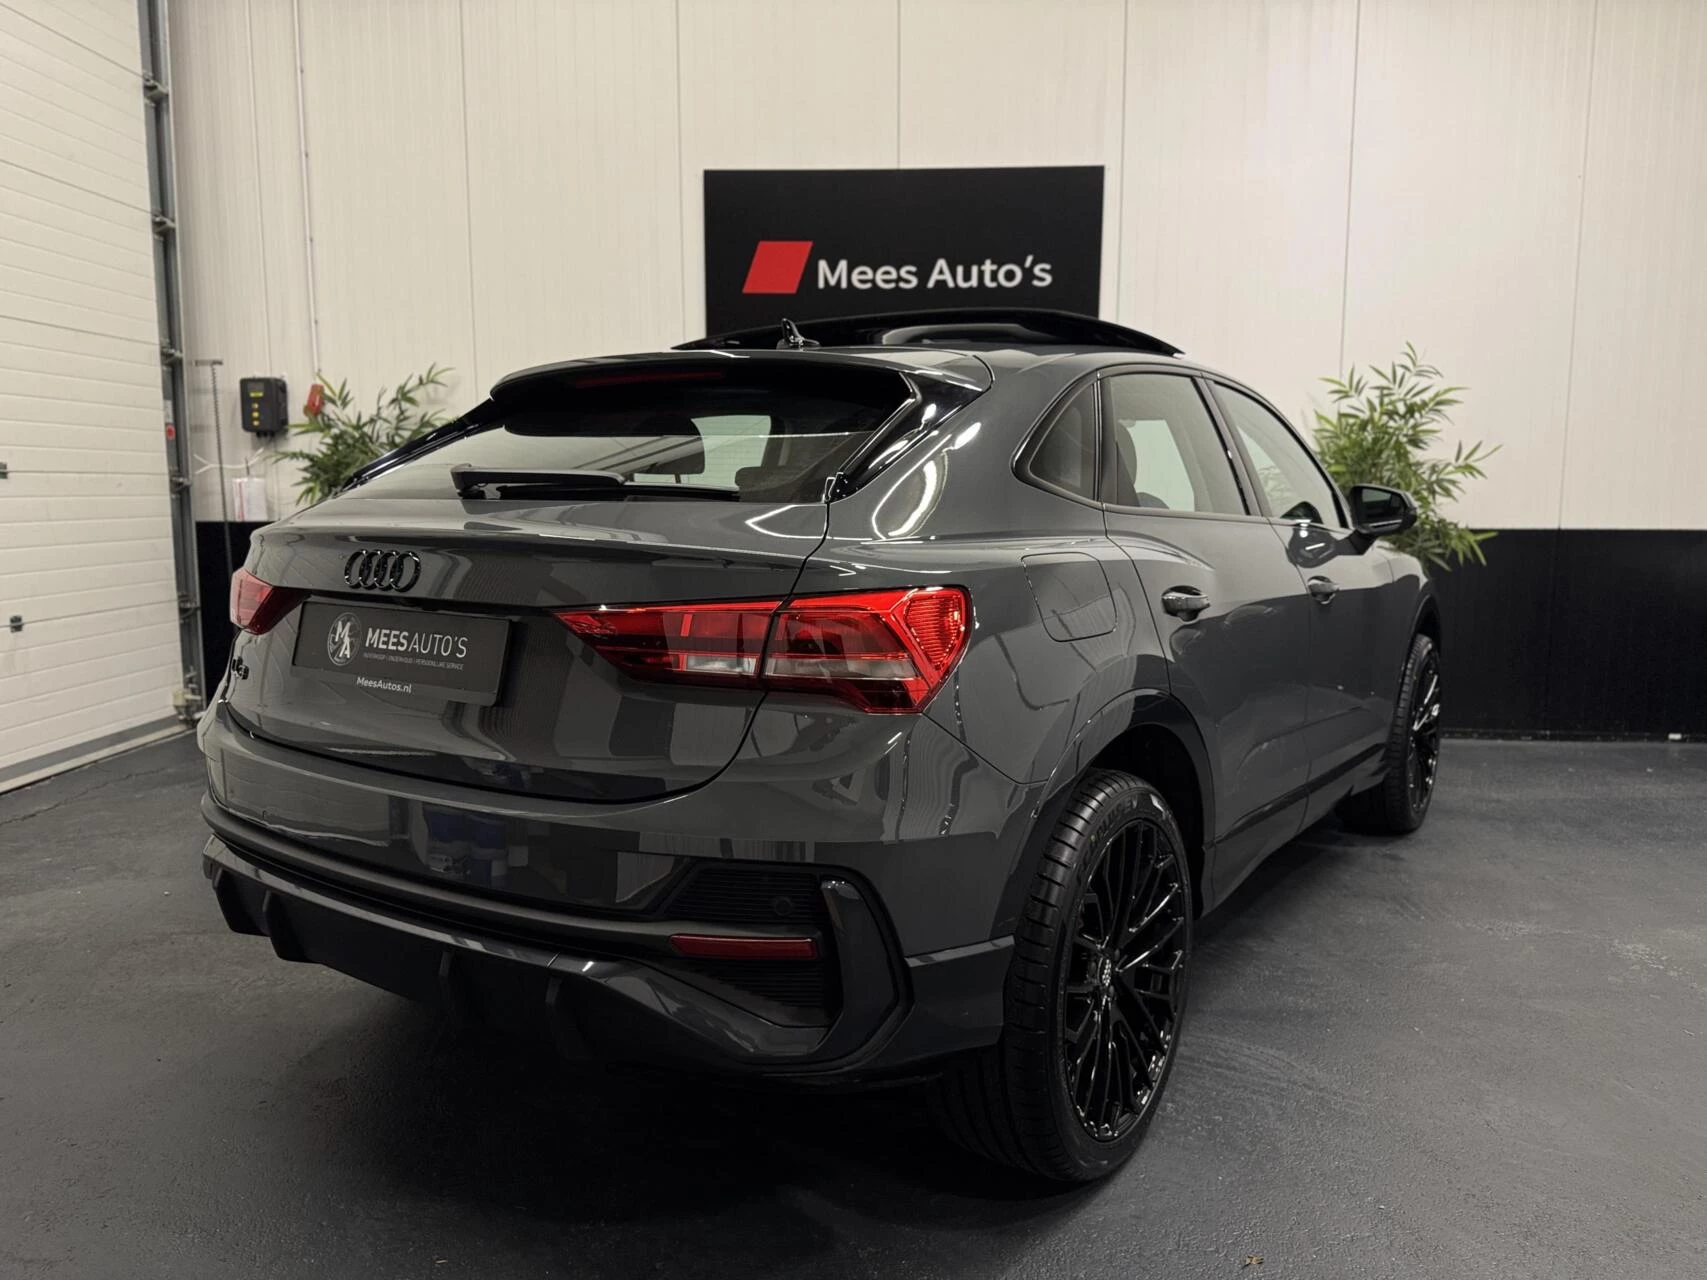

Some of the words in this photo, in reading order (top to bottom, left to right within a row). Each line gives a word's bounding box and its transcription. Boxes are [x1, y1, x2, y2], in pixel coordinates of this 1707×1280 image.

[817, 259, 919, 289] Mees
[926, 254, 1053, 289] Auto's
[356, 676, 412, 694] MeesAutos.nl
